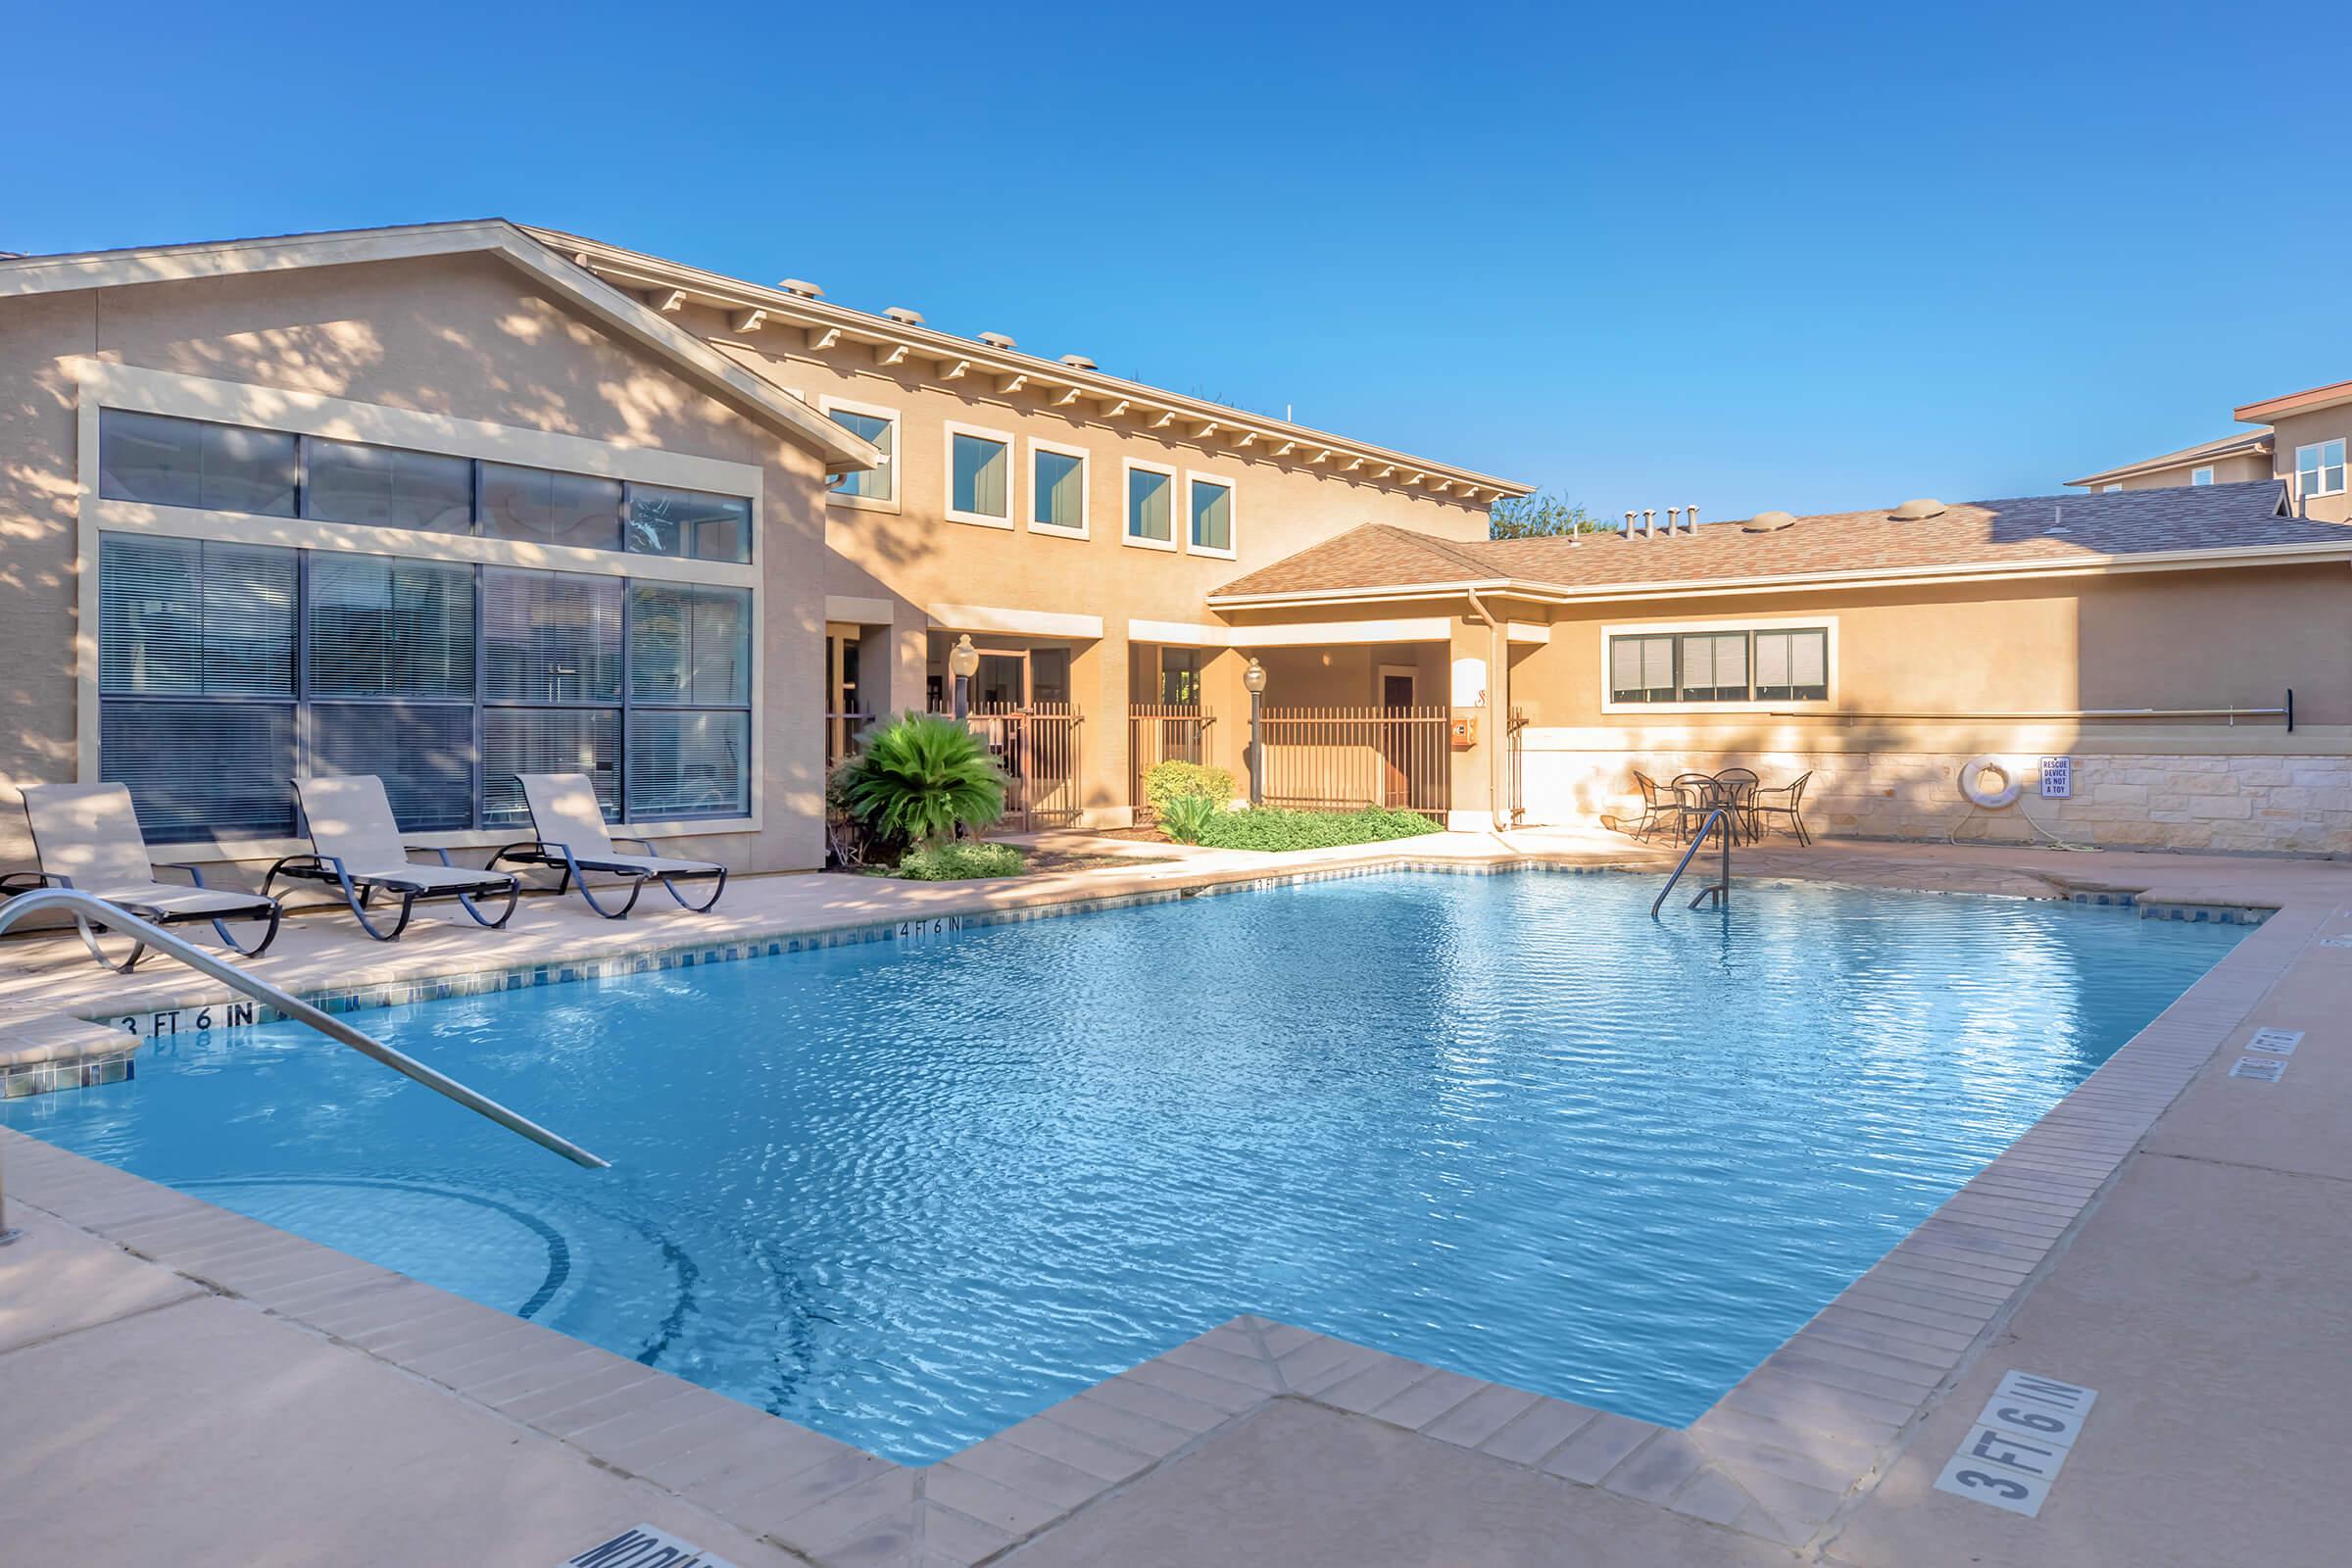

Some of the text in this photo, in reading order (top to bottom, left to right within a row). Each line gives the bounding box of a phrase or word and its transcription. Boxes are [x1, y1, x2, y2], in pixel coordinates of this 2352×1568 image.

[901, 916, 959, 938] 4 FT 6 IN
[154, 1011, 180, 1036] FT
[196, 1007, 212, 1030] 6
[227, 1003, 253, 1027] IN
[1956, 1375, 2082, 1500] 3 FT 6 IN
